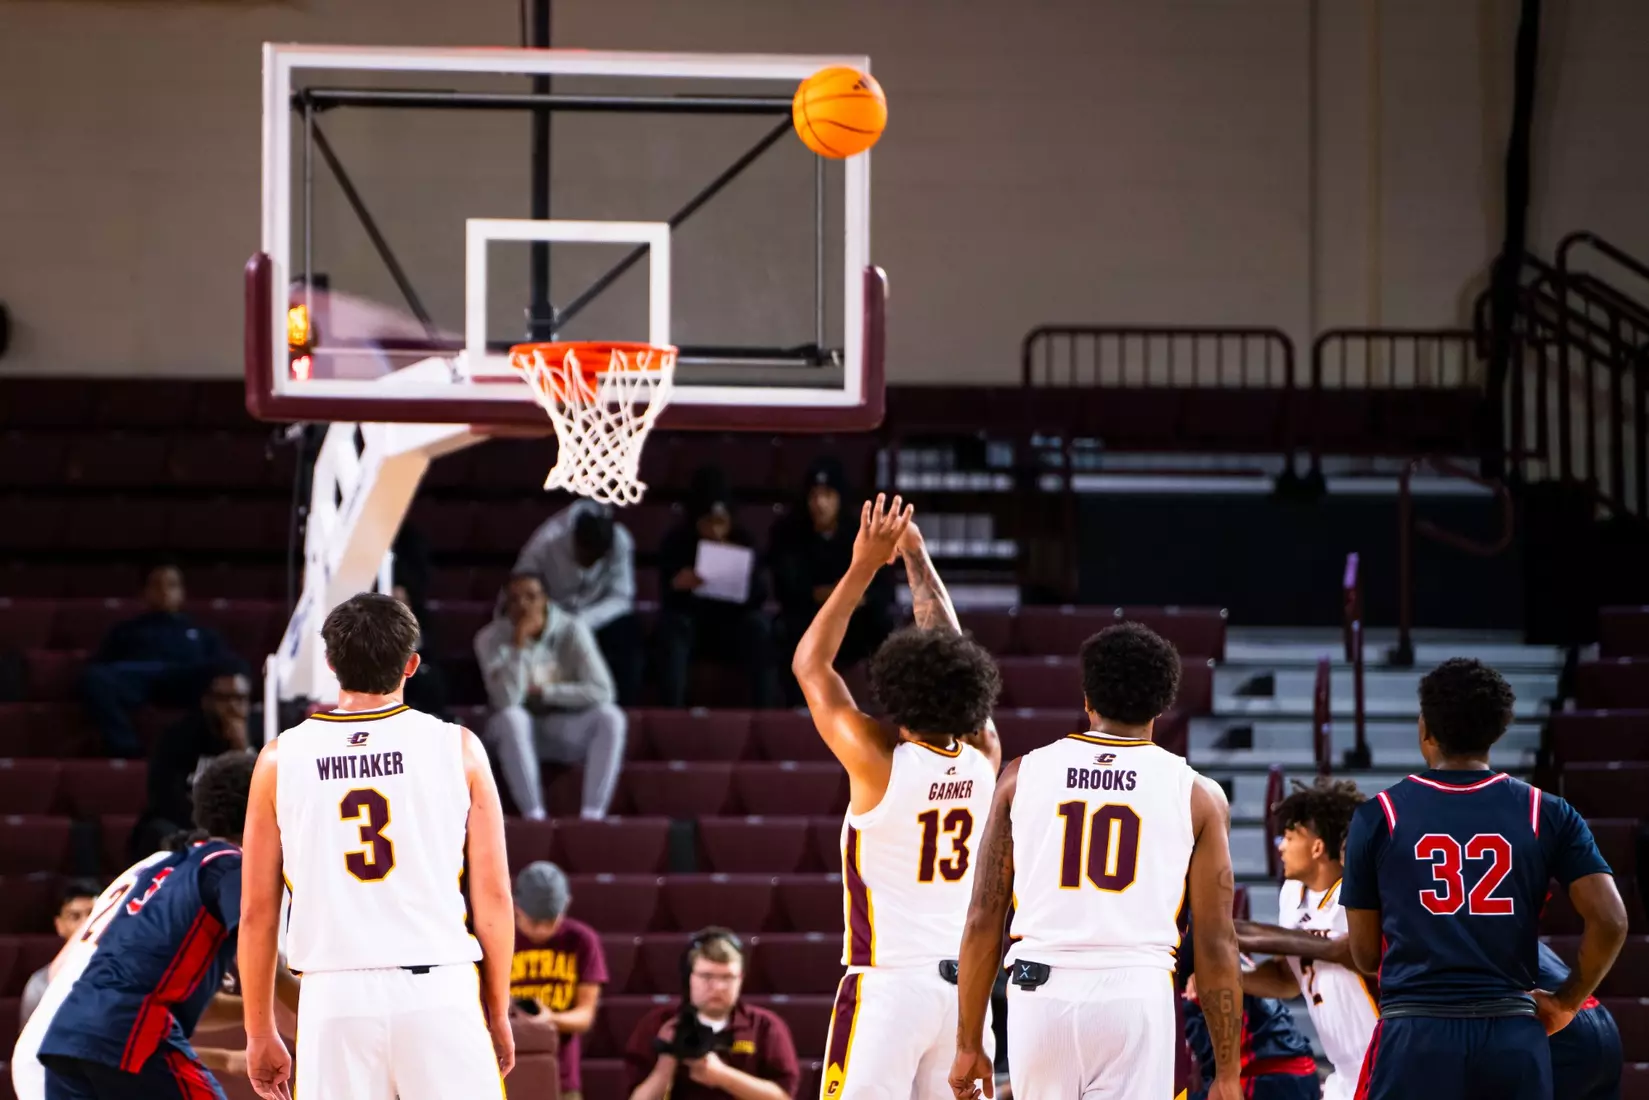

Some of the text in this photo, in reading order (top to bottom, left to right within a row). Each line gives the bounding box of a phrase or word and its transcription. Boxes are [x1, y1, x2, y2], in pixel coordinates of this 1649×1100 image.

[316, 751, 404, 781] WHITAKER
[928, 779, 974, 801] GARNER
[1066, 767, 1137, 791] BROOKS
[338, 786, 396, 883] 3
[917, 808, 975, 883] 13
[1056, 800, 1143, 894] 10
[1414, 833, 1514, 915] 32
